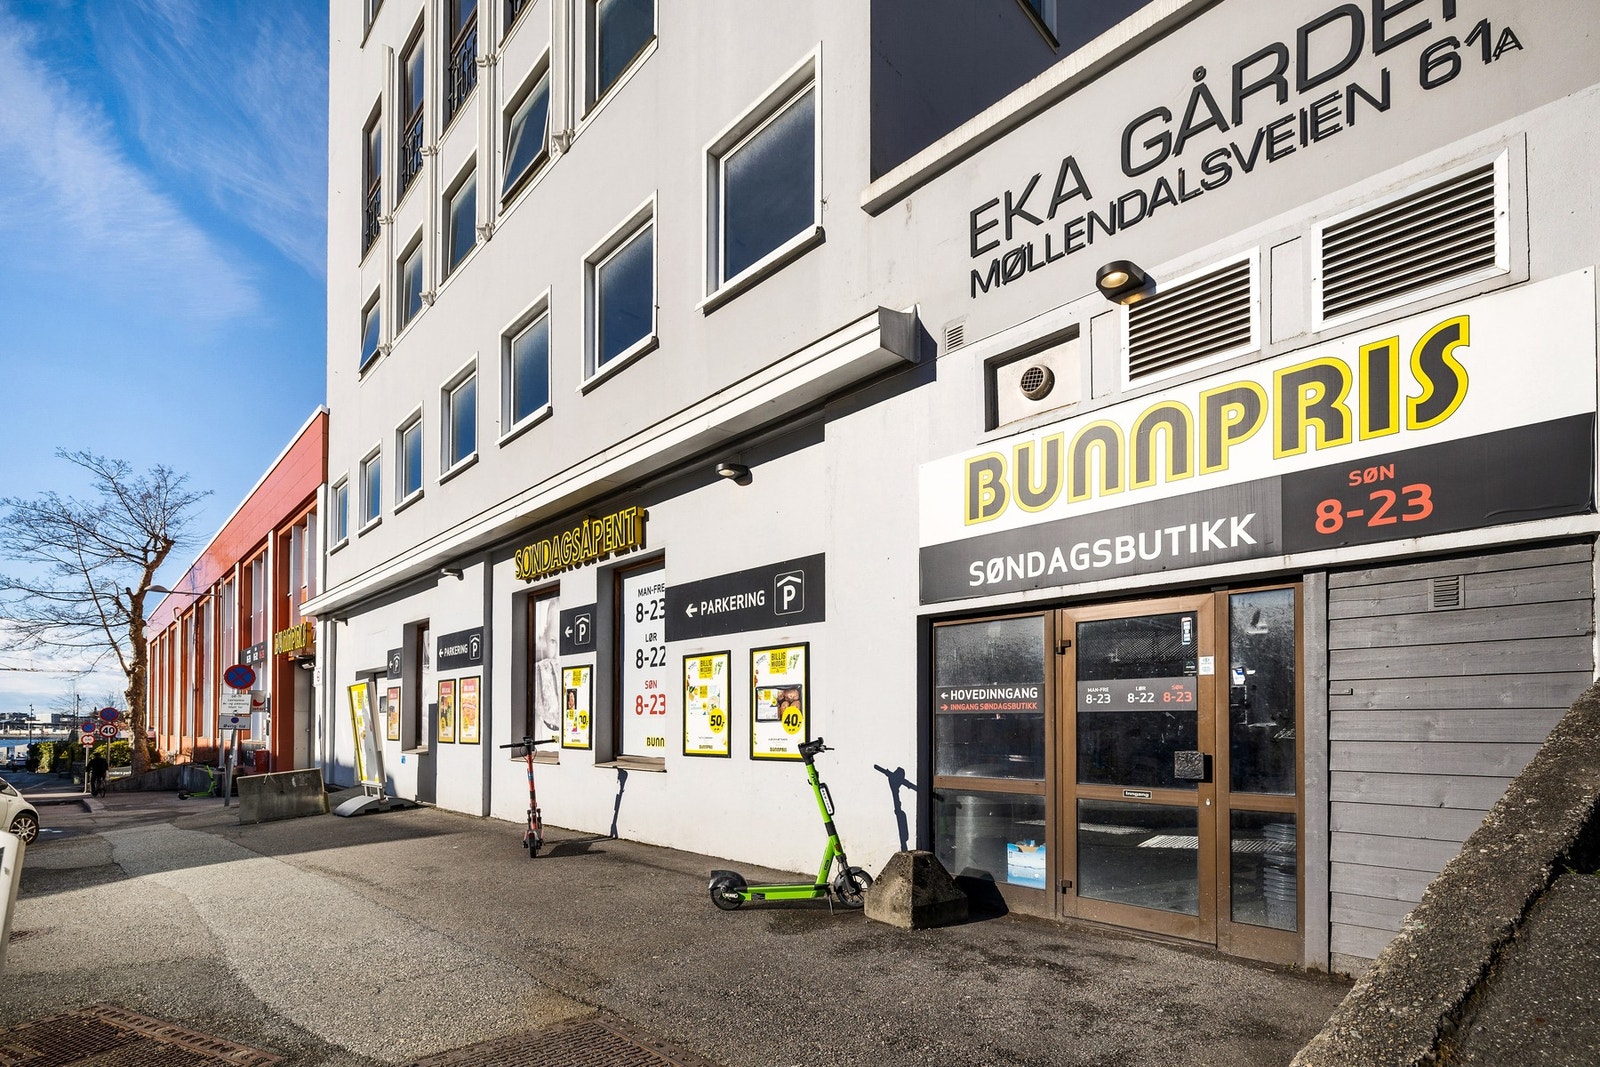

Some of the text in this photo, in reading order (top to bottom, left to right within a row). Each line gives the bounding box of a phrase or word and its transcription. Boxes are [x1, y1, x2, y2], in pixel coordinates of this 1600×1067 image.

[970, 67, 1391, 299] MØLLENDALSVEIEN
[970, 155, 1093, 258] EKA
[964, 315, 1470, 527] BUNNPRIS
[1348, 463, 1396, 487] SØN
[1315, 483, 1435, 535] 8-23
[967, 512, 1257, 587] SØNDAGSBUTIKK
[637, 583, 666, 597] MAN-FRE
[635, 598, 666, 624] 8-23
[700, 589, 765, 616] PARKERING
[645, 632, 658, 643] LØR
[444, 644, 468, 657] PARKERING
[635, 646, 666, 669] 8-22
[644, 680, 658, 690] SØN
[950, 687, 1038, 701] HOVEDINNGANG
[635, 693, 667, 716] 8-23
[1085, 693, 1111, 704] 8-23
[1127, 692, 1155, 703] 8-22
[1163, 691, 1193, 703] 8-23
[950, 702, 1038, 711] INNGANG SØNDAGSBUTIKK
[102, 726, 116, 734] 40
